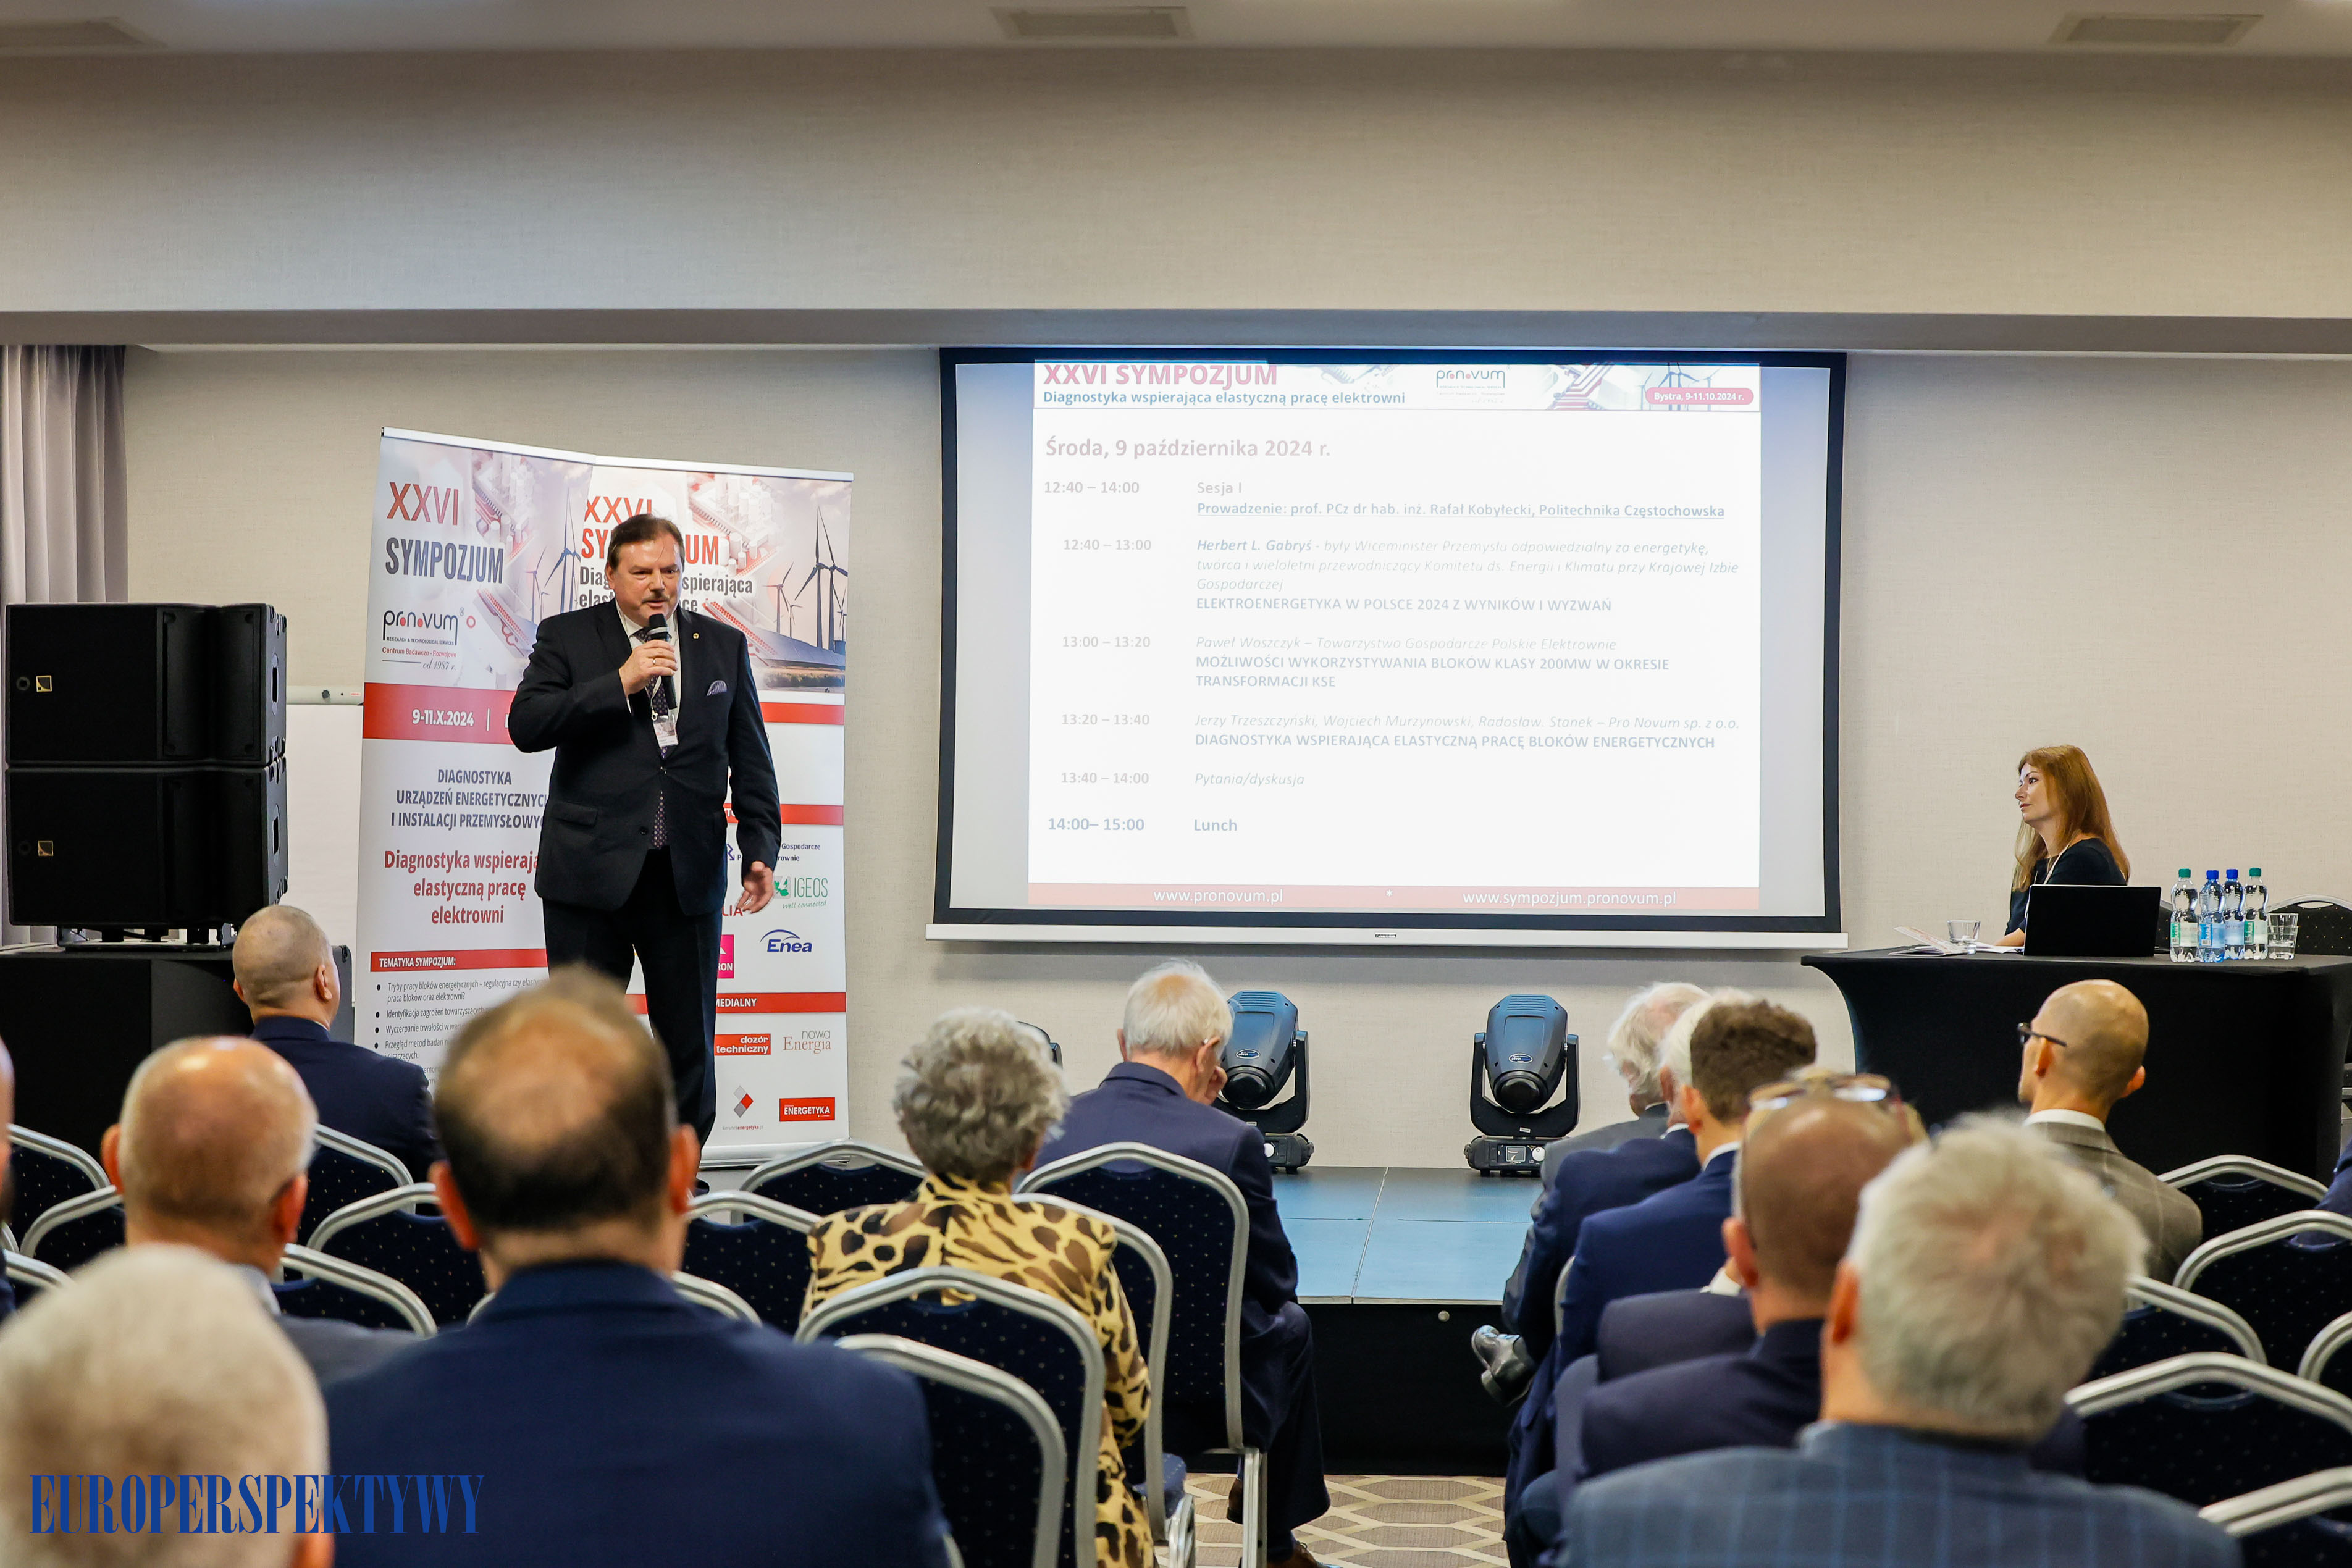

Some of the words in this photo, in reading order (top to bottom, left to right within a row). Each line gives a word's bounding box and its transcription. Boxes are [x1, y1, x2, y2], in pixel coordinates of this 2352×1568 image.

[1044, 364, 1107, 384] XXVI
[1115, 364, 1277, 390] SYMPOZJUM
[1044, 391, 1127, 405] Diagnostyka
[1131, 392, 1211, 406] wspierająca
[1216, 392, 1286, 406] elastyczną
[1292, 395, 1327, 406] pracę
[1332, 392, 1405, 403] elektrowni
[1654, 392, 1684, 403] Bystra,
[1685, 392, 1736, 401] 9-11.10.2024
[1046, 435, 1109, 459] Środa,
[1116, 440, 1127, 456] 9
[1134, 439, 1258, 459] października
[1265, 440, 1312, 456] 2024
[1320, 444, 1330, 456] r.
[1045, 482, 1083, 493] 12:40
[1101, 482, 1139, 493] 14:00
[1198, 482, 1233, 496] Sesja
[387, 482, 459, 526] XXVI
[1198, 503, 1287, 514] Prowadzenie:
[1290, 503, 1322, 517] prof.
[1327, 504, 1348, 514] PCz
[1353, 503, 1366, 514] dr
[1371, 503, 1399, 514] hab.
[1405, 504, 1426, 514] inż.
[1431, 503, 1464, 514] Rafał
[1468, 504, 1535, 518] Kobyłecki,
[1540, 503, 1620, 516] Politechnika
[1624, 505, 1724, 518] Częstochowska
[1064, 539, 1099, 550] 12:40
[1116, 540, 1151, 550] 13:00
[1197, 539, 1248, 550] Herbert
[1266, 540, 1312, 553] Gabryś
[1325, 540, 1350, 553] były
[1355, 541, 1438, 551] Wiceminister
[1443, 541, 1507, 553] Przemysłu
[1512, 541, 1612, 555] odpowiedzialny
[1616, 545, 1629, 553] za
[1634, 542, 1708, 556] energetykę,
[385, 537, 504, 584] SYMPOZJUM
[1198, 559, 1240, 570] twórca
[1253, 559, 1314, 570] wieloletni
[1319, 558, 1421, 573] przewodniczący
[1425, 561, 1482, 571] Komitetu
[1487, 561, 1503, 571] ds.
[1510, 561, 1553, 574] Energii
[1565, 561, 1614, 573] Klimatu
[1618, 564, 1645, 575] przy
[1649, 562, 1705, 576] Krajowej
[1710, 562, 1738, 573] Izbie
[682, 573, 752, 598] spierająca
[1197, 579, 1283, 592] Gospodarczej
[1197, 598, 1341, 609] ELEKTROENERGETYKA
[1364, 599, 1413, 610] POLSCE
[1418, 599, 1448, 610] 2024
[1464, 597, 1535, 610] WYNIKÓW
[1548, 598, 1611, 611] WYZWAŃ
[1063, 637, 1098, 647] 13:00
[1115, 637, 1150, 647] 13:20
[1196, 637, 1235, 647] Paweł
[1240, 637, 1300, 650] Woszczyk
[1317, 637, 1402, 651] Towarzystwo
[1406, 637, 1487, 652] Gospodarcze
[1492, 638, 1536, 649] Polskie
[1542, 639, 1616, 650] Elektrownie
[382, 647, 405, 655] Centrum
[433, 650, 456, 659] Rozwojowe
[423, 658, 433, 669] od
[434, 661, 450, 670] 1987
[1196, 654, 1283, 668] MOŻLIWOŚCI
[1288, 657, 1426, 668] WYKORZYSTYWANIA
[1432, 656, 1490, 668] BLOKÓW
[1496, 658, 1535, 669] KLASY
[1540, 658, 1591, 669] 200MW
[1596, 659, 1610, 669] W
[1614, 659, 1669, 669] OKRESIE
[1196, 676, 1308, 687] TRANSFORMACJI
[1313, 677, 1335, 687] KSE
[412, 709, 474, 727] 9-11.X.2024
[1062, 714, 1098, 725] 13:20
[1114, 715, 1149, 725] 13:40
[1195, 715, 1226, 728] Jerzy
[1231, 715, 1317, 728] Trzeszczyński,
[1324, 715, 1380, 729] Wojciech
[1386, 716, 1474, 729] Murzynowski,
[1479, 716, 1544, 727] Radosław.
[1549, 716, 1593, 727] Stanek
[1608, 717, 1630, 727] Pro
[1634, 718, 1679, 728] Novum
[1684, 720, 1701, 731] sp.
[1716, 720, 1739, 729] o.o.
[1196, 734, 1292, 745] DIAGNOSTYKA
[1296, 735, 1390, 748] WSPIERAJĄCA
[1395, 736, 1477, 749] ELASTYCZNĄ
[1482, 736, 1524, 750] PRACĘ
[1529, 735, 1588, 747] BLOKÓW
[1594, 737, 1714, 748] ENERGETYCZNYCH
[437, 769, 512, 785] DIAGNOSTYKA
[1062, 773, 1097, 783] 13:40
[1114, 773, 1149, 784] 14:00
[1195, 773, 1304, 787] Pytania/dyskusja
[397, 787, 453, 808] URZĄDZEŃ
[391, 812, 395, 826] I
[398, 812, 456, 831] INSTALACJI
[460, 814, 543, 829] PRZEMYSŁOWY
[1049, 818, 1099, 830] 14:00–
[1104, 818, 1144, 831] 15:00
[1195, 818, 1237, 831] Lunch
[781, 843, 821, 851] Gospodarcze
[385, 849, 470, 873] Diagnostyka
[413, 878, 484, 901] elastyczną
[488, 882, 526, 901] pracę
[794, 878, 828, 898] IGEOS
[797, 900, 827, 908] connected
[1154, 889, 1282, 905] www.pronovum.pl
[1463, 891, 1675, 908] www.sympozjum.pronovum.pl
[432, 905, 504, 924] elektrowni
[767, 939, 812, 952] Enea
[379, 958, 414, 968] TEMATYKA
[415, 957, 456, 968] SYMPOZJUM:
[388, 983, 402, 992] Tryby
[403, 984, 418, 992] pracy
[419, 981, 438, 989] bloków
[439, 980, 479, 991] energetycznych
[484, 979, 511, 989] regulacyjna
[387, 995, 401, 1004] praca
[403, 993, 422, 1002] bloków
[436, 992, 465, 1000] elektrowni?
[387, 1008, 419, 1020] Identyfikacja
[421, 1008, 443, 1018] zagrożeń
[386, 1024, 419, 1035] Wyczerpanie
[420, 1023, 443, 1031] trwałości
[802, 1029, 831, 1039] nowa
[385, 1039, 407, 1050] Przegląd
[408, 1039, 426, 1047] metod
[427, 1038, 443, 1047] badań
[740, 1036, 769, 1044] dozór
[783, 1036, 831, 1054] Energia
[716, 1044, 769, 1054] techniczny
[784, 1106, 831, 1115] ENERGETYKA
